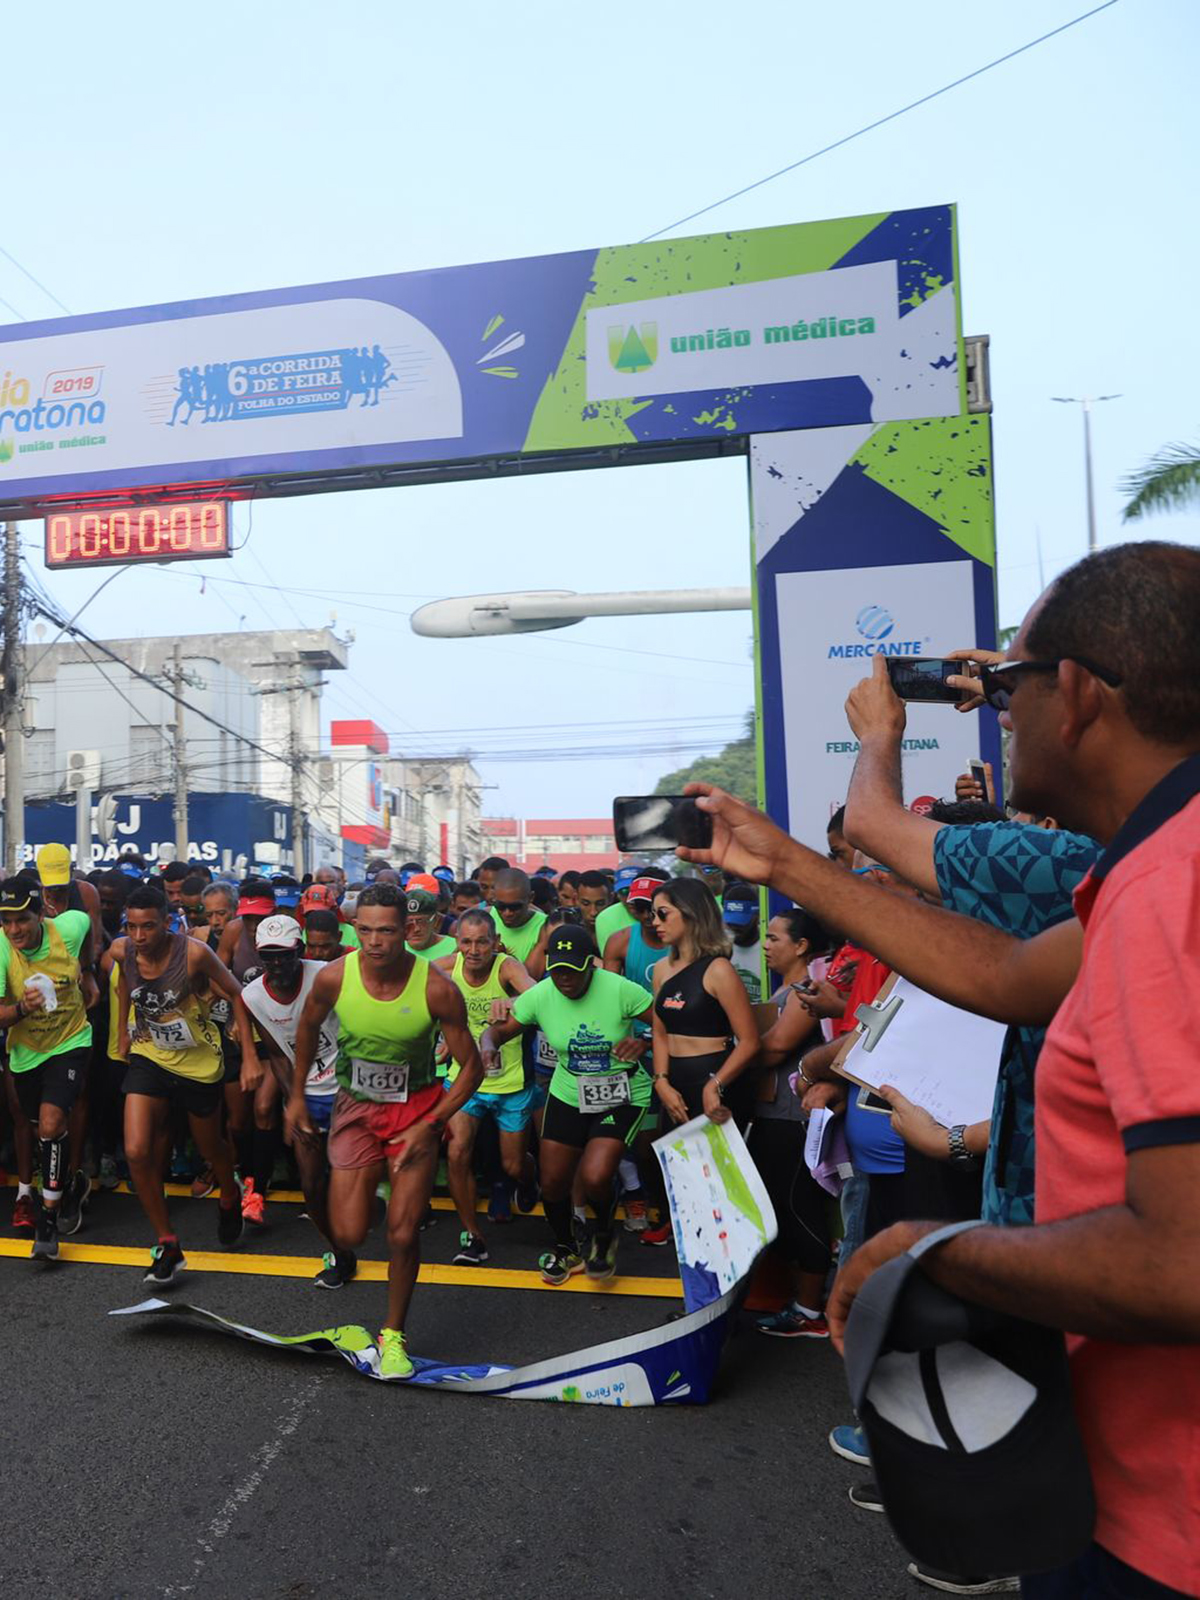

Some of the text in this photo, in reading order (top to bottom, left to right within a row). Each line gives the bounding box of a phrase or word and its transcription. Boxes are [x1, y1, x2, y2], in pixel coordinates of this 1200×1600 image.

[670, 316, 876, 354] união médica
[260, 355, 342, 375] CORRIDA
[52, 376, 94, 393] 2019
[253, 371, 343, 393] DE FEIRA
[238, 391, 340, 410] FOLHA DO ESTADO
[19, 435, 106, 453] união médica
[51, 504, 223, 559] 00:00:00
[828, 641, 922, 659] MERCANTE
[826, 742, 861, 754] FEIRA
[585, 1082, 628, 1101] 384
